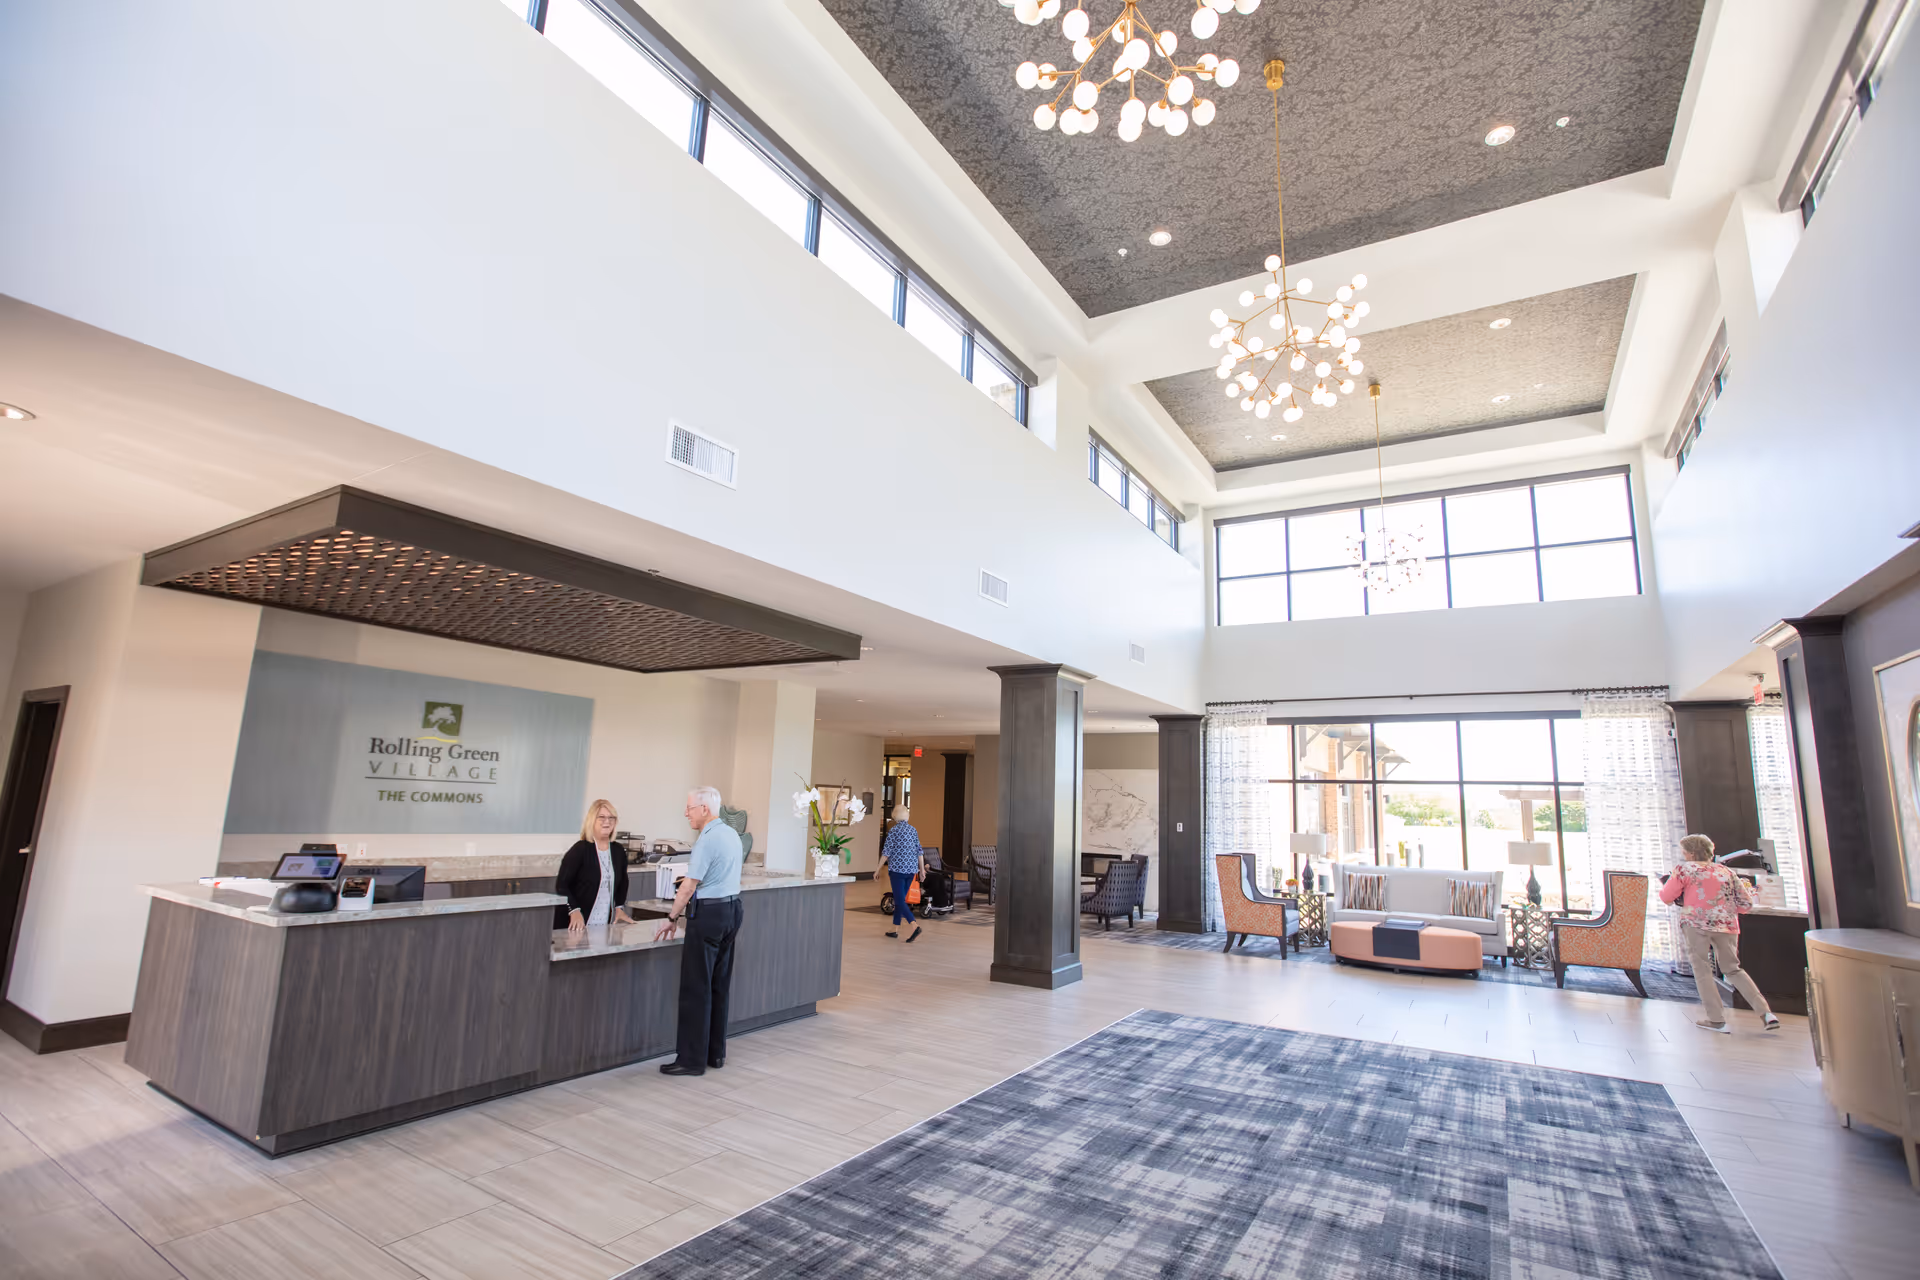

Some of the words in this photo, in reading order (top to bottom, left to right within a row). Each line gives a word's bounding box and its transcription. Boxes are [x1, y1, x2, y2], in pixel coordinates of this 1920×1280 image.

[369, 737, 443, 763] Rolling
[448, 744, 499, 762] Green
[368, 760, 497, 780] VILLAGE
[377, 790, 406, 802] THE
[410, 791, 483, 804] COMMONS
